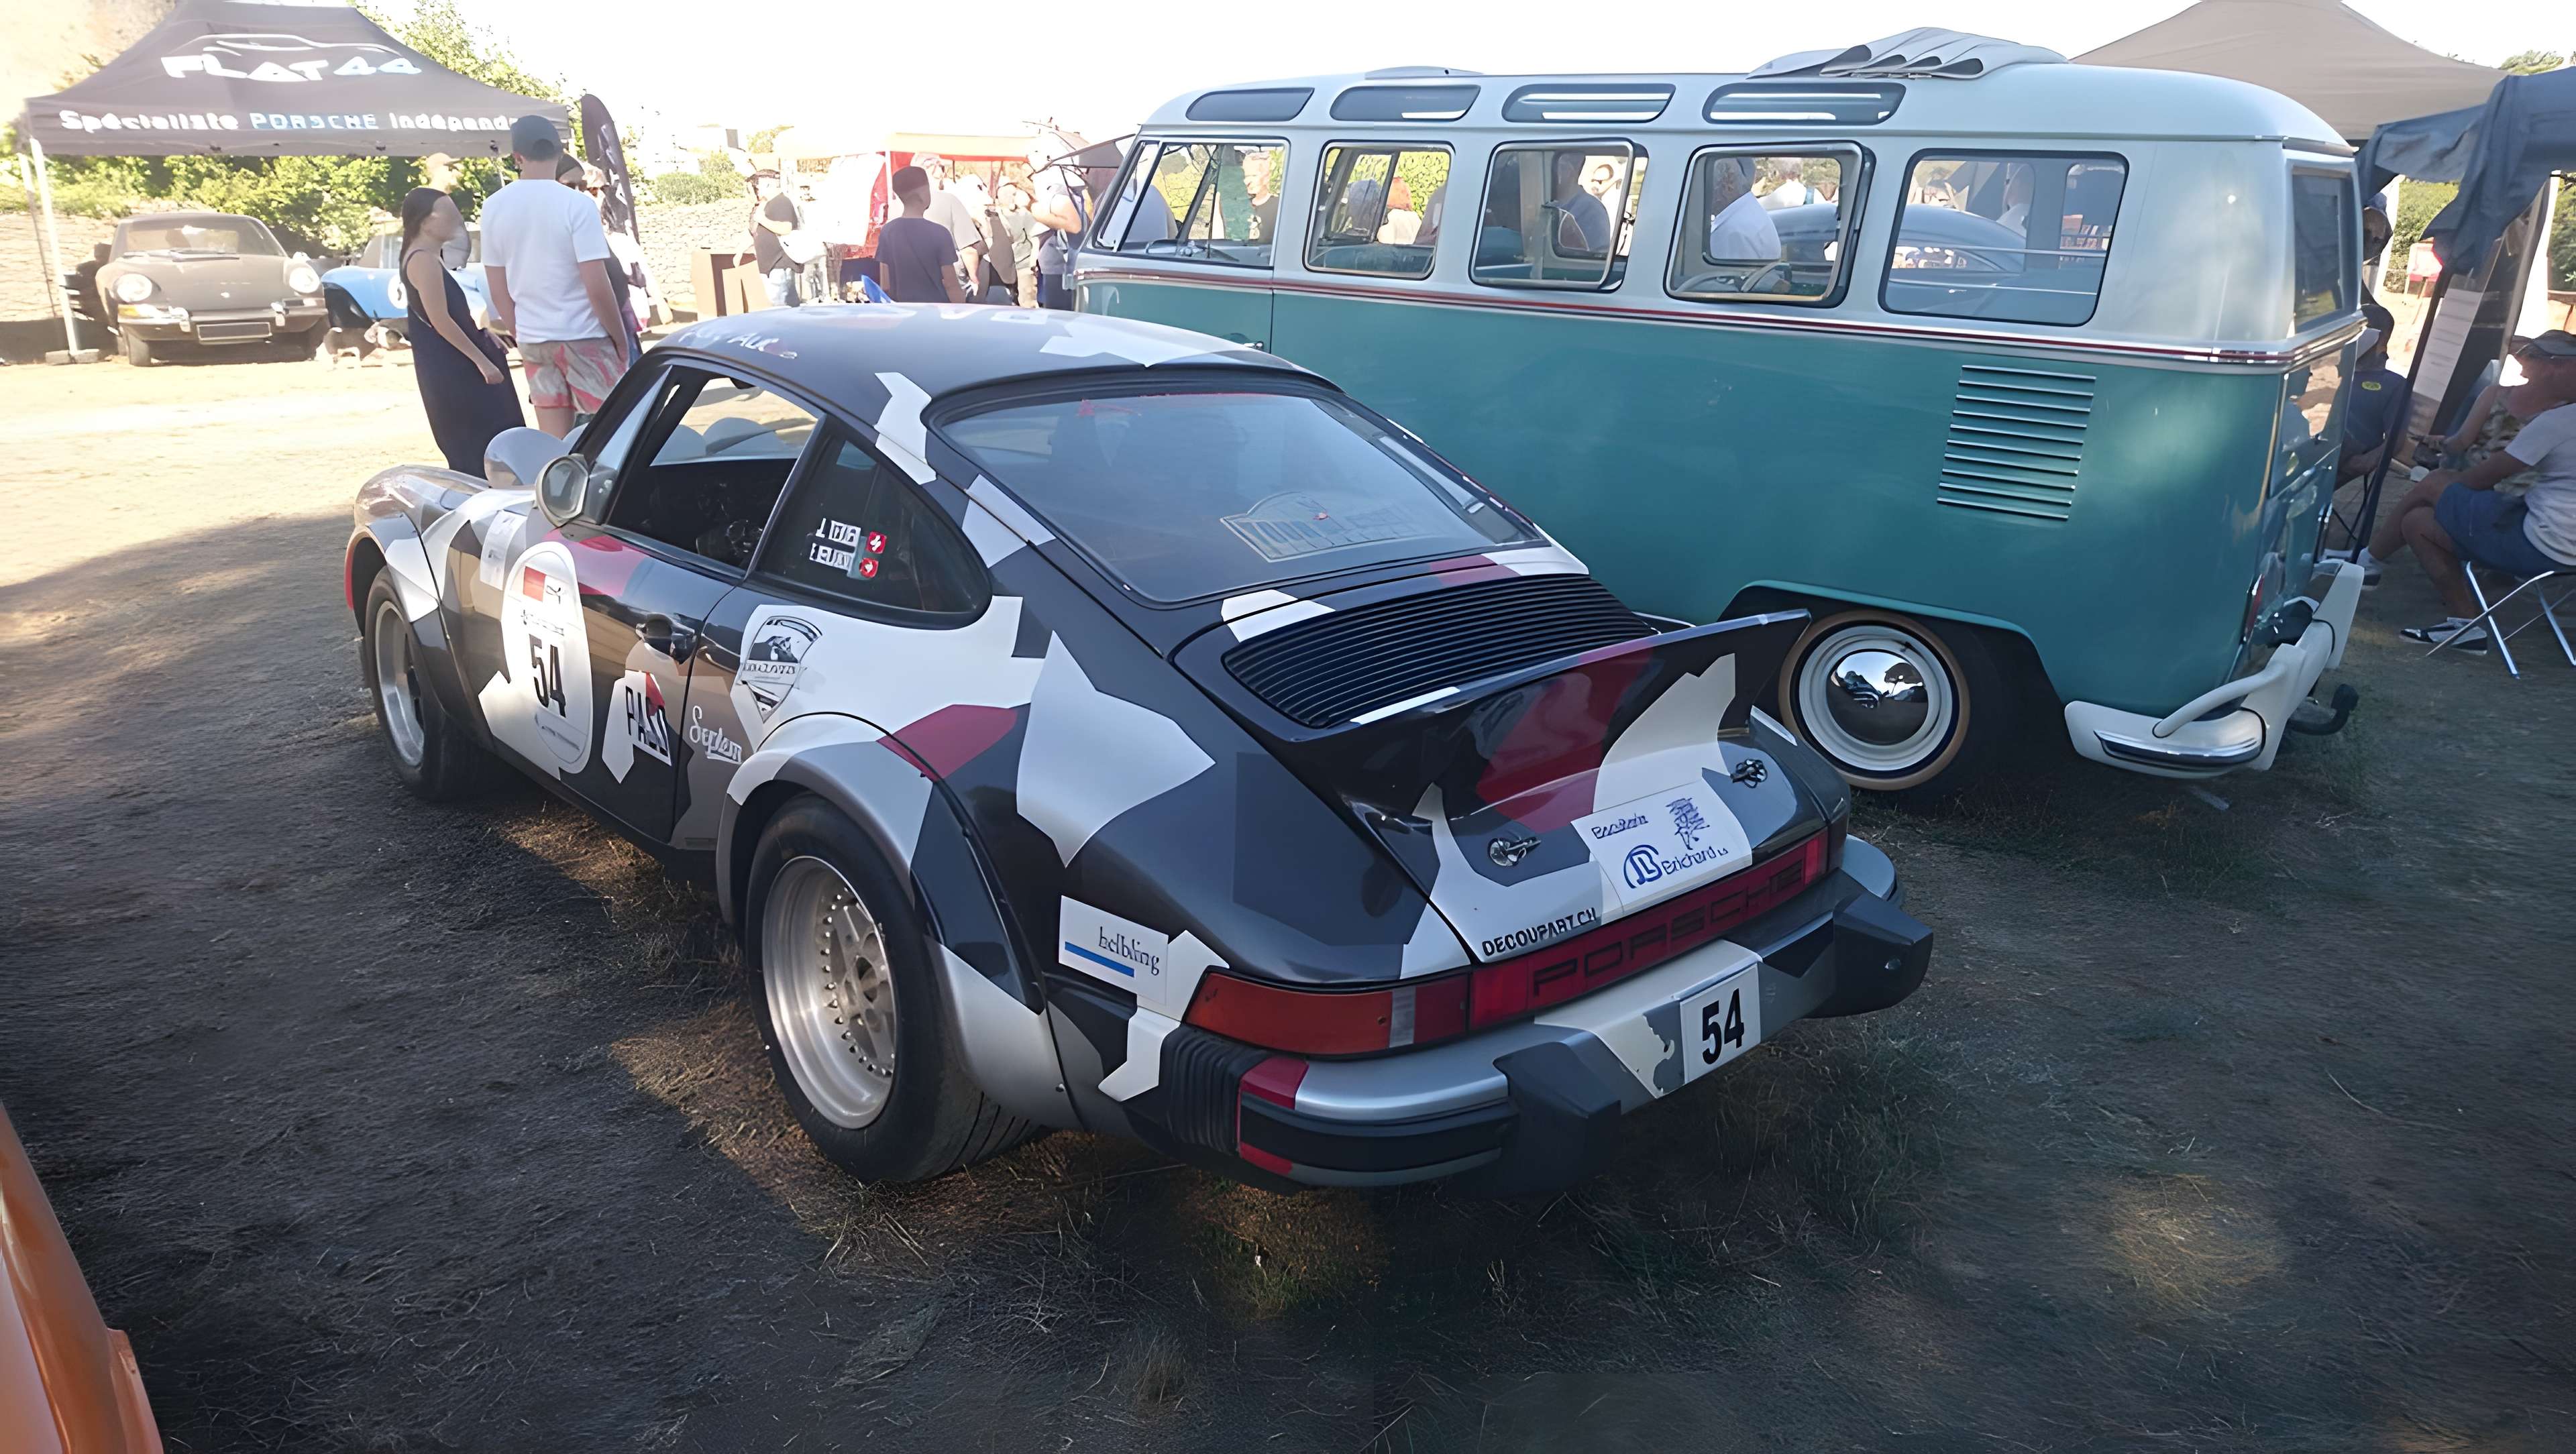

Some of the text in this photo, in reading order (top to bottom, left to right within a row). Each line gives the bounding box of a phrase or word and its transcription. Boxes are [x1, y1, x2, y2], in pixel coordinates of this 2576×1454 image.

[249, 112, 379, 129] PORSCHE
[529, 633, 567, 718] 54
[1534, 863, 1803, 997] PORSCHE
[1702, 987, 1744, 1065] 54
